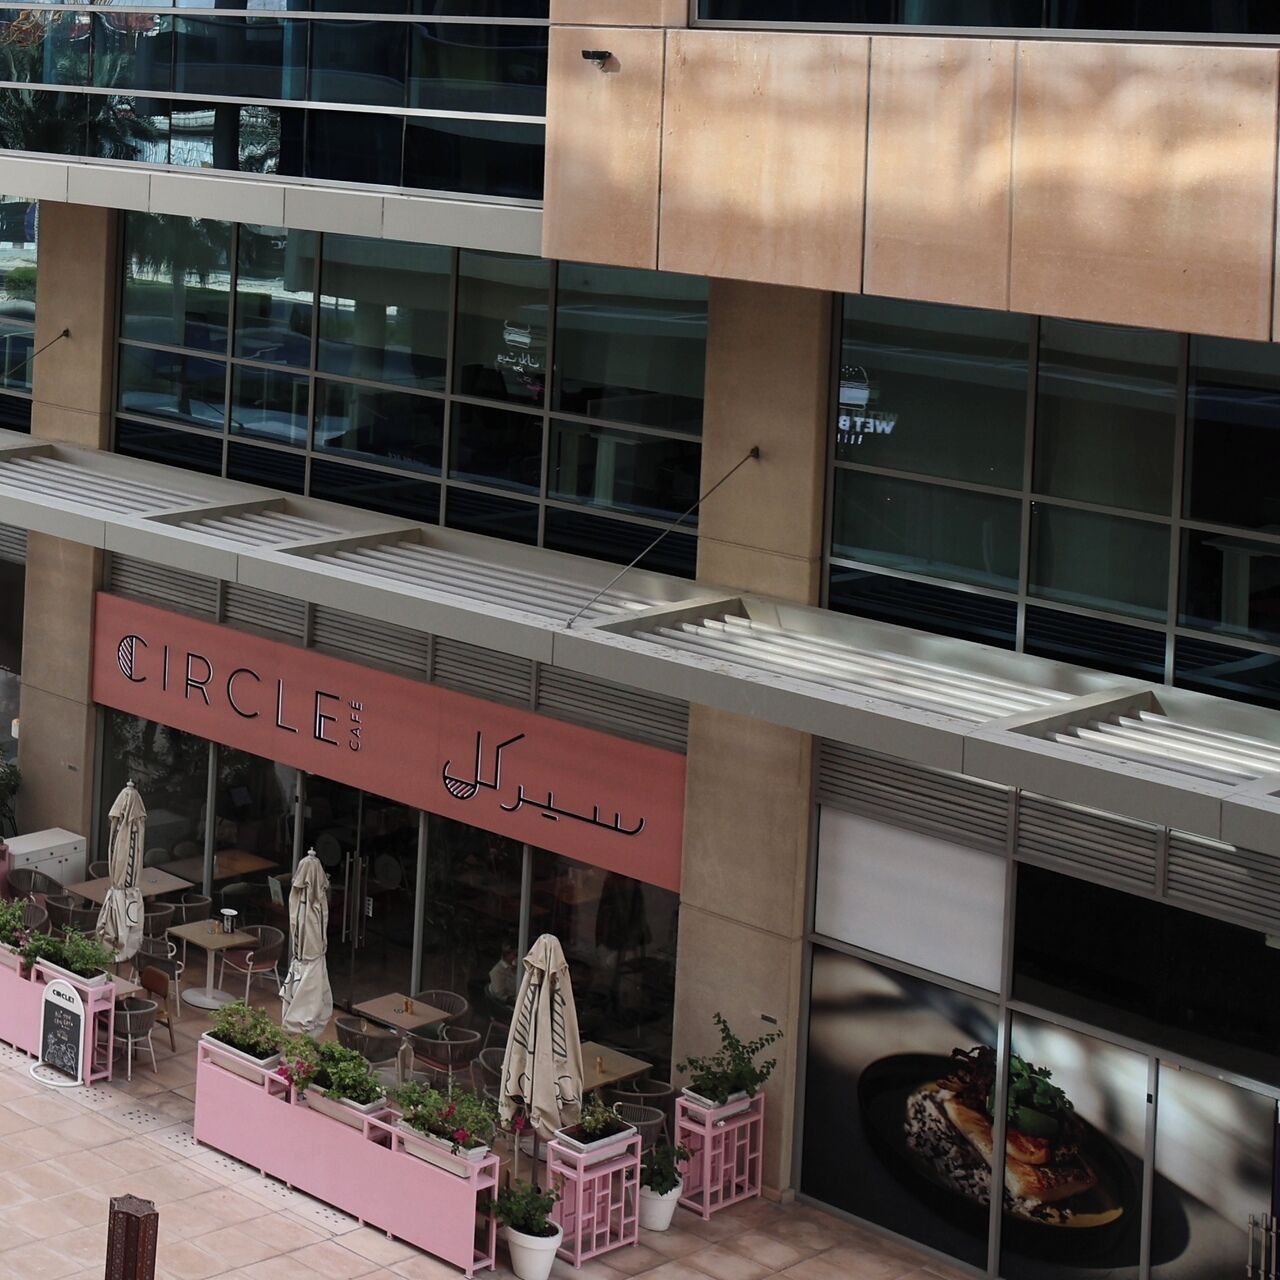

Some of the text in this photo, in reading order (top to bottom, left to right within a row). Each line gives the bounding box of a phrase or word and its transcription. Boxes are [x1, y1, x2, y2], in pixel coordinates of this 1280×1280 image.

[117, 634, 341, 747] CIRCLE
[348, 699, 364, 753] CAFÉ
[442, 730, 646, 837] سيركل
